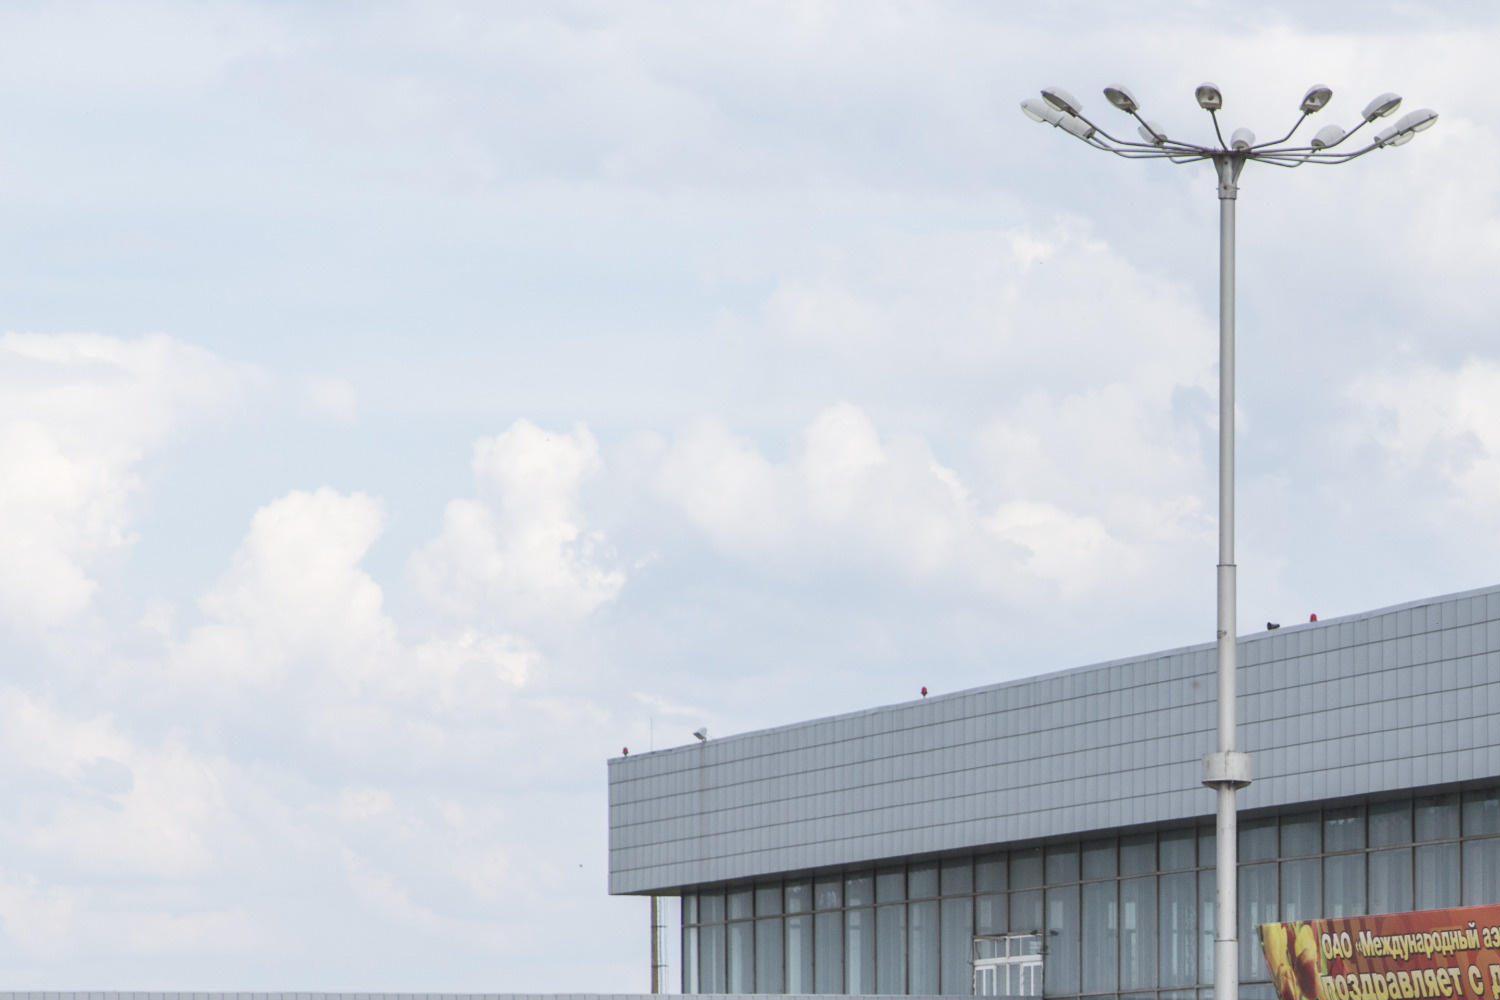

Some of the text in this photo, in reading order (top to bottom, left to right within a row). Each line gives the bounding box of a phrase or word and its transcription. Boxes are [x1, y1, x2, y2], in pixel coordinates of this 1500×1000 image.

[1321, 931, 1352, 960] ОАО
[1356, 921, 1480, 961] «Международный
[1468, 964, 1484, 995] с
